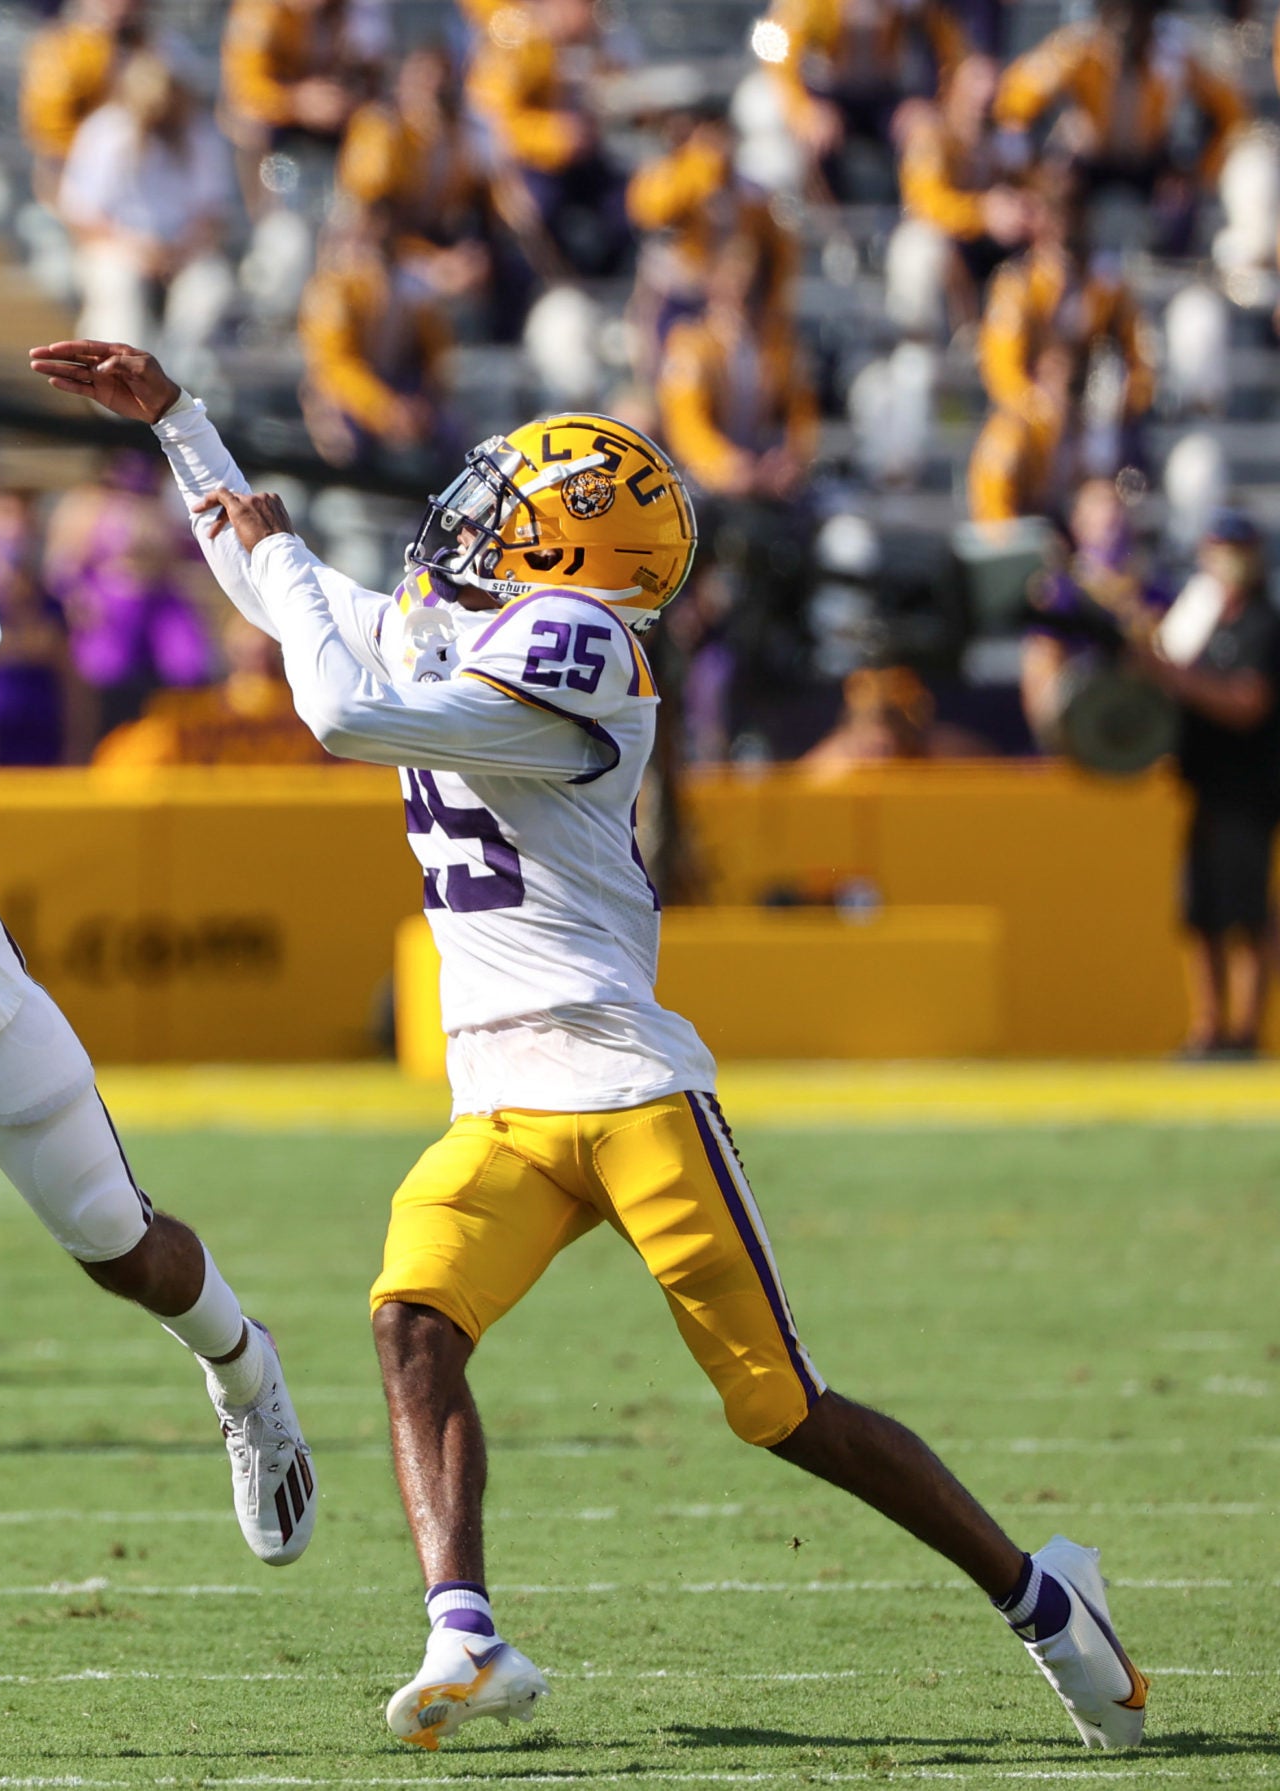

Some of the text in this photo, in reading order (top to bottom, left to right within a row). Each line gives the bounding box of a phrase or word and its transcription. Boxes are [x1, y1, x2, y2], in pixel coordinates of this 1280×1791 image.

[542, 433, 667, 507] LSU
[492, 581, 532, 593] schutt
[522, 620, 611, 694] 25
